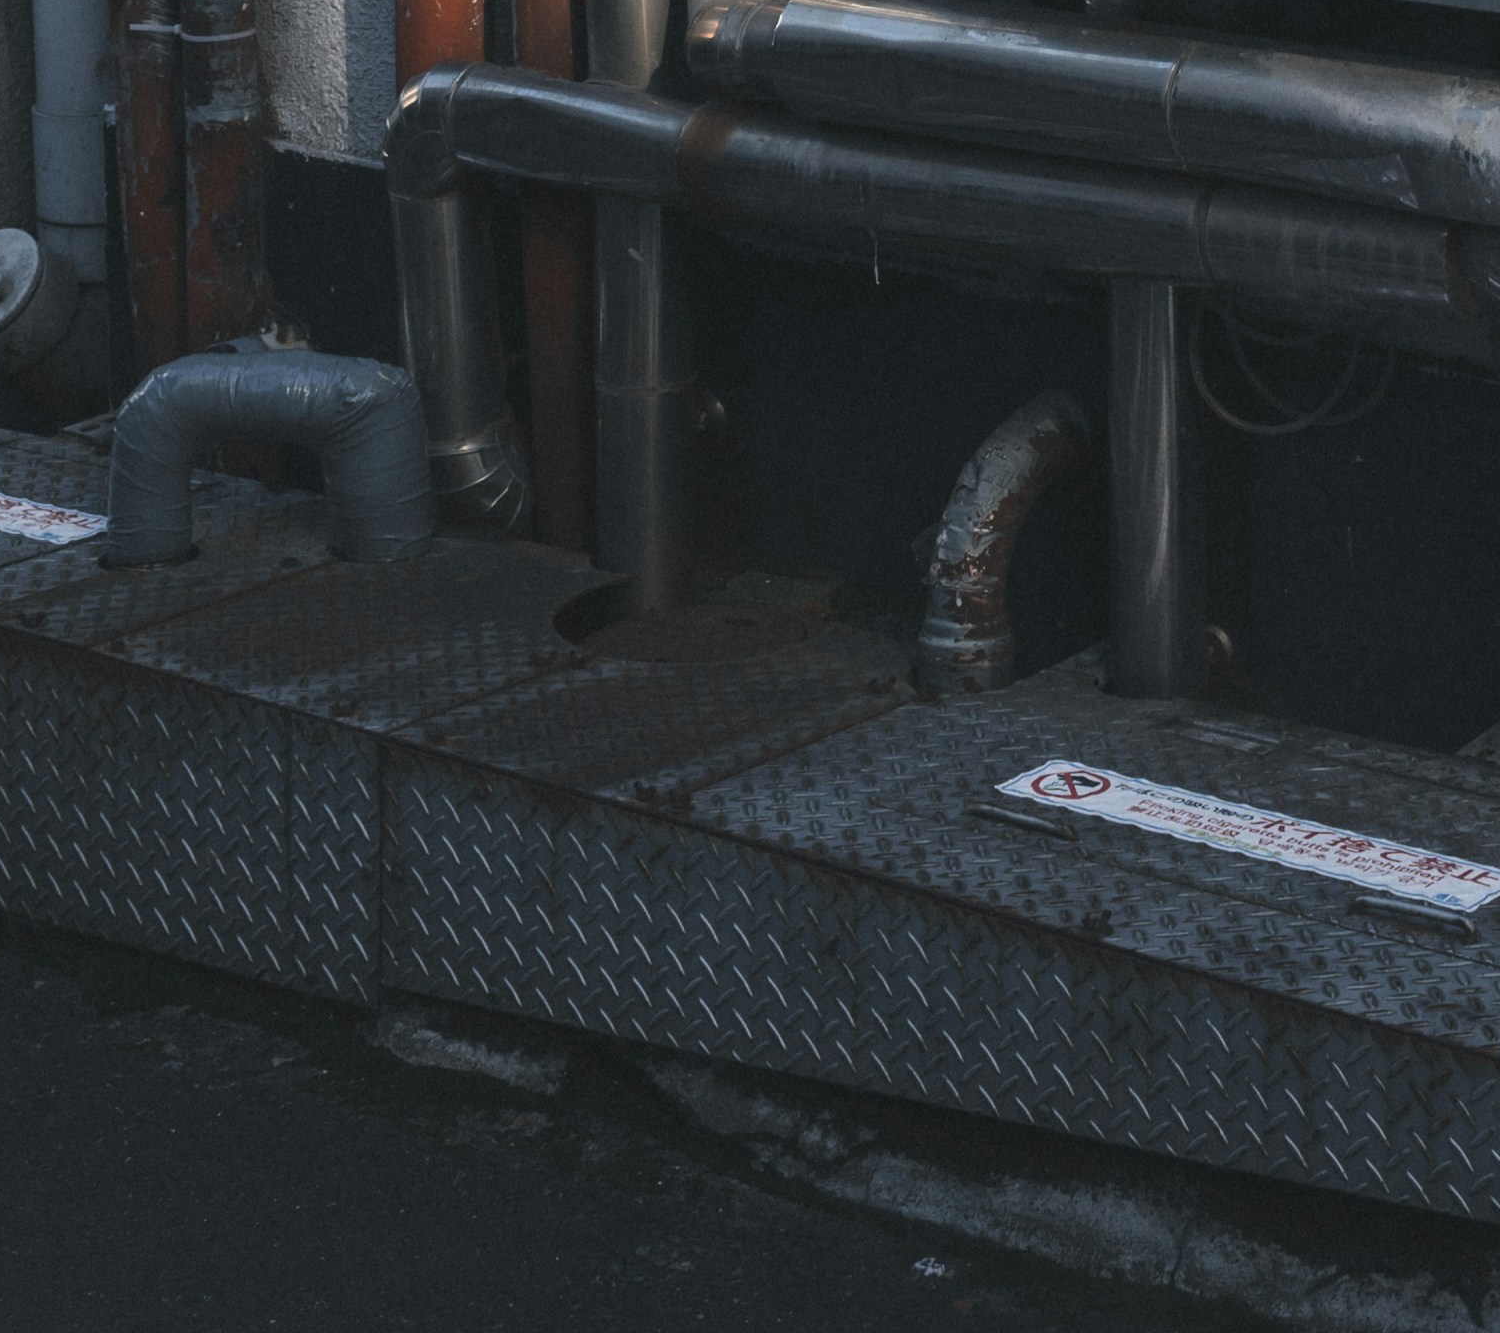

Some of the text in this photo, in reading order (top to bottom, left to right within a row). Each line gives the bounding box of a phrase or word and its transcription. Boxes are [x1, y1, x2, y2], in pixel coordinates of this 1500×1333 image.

[1138, 799, 1204, 820] Flicking
[1207, 817, 1283, 840] cigarette
[1286, 836, 1330, 853] butts
[1353, 854, 1446, 883] prohibited
[1249, 816, 1500, 889] ポイ捨て禁止
